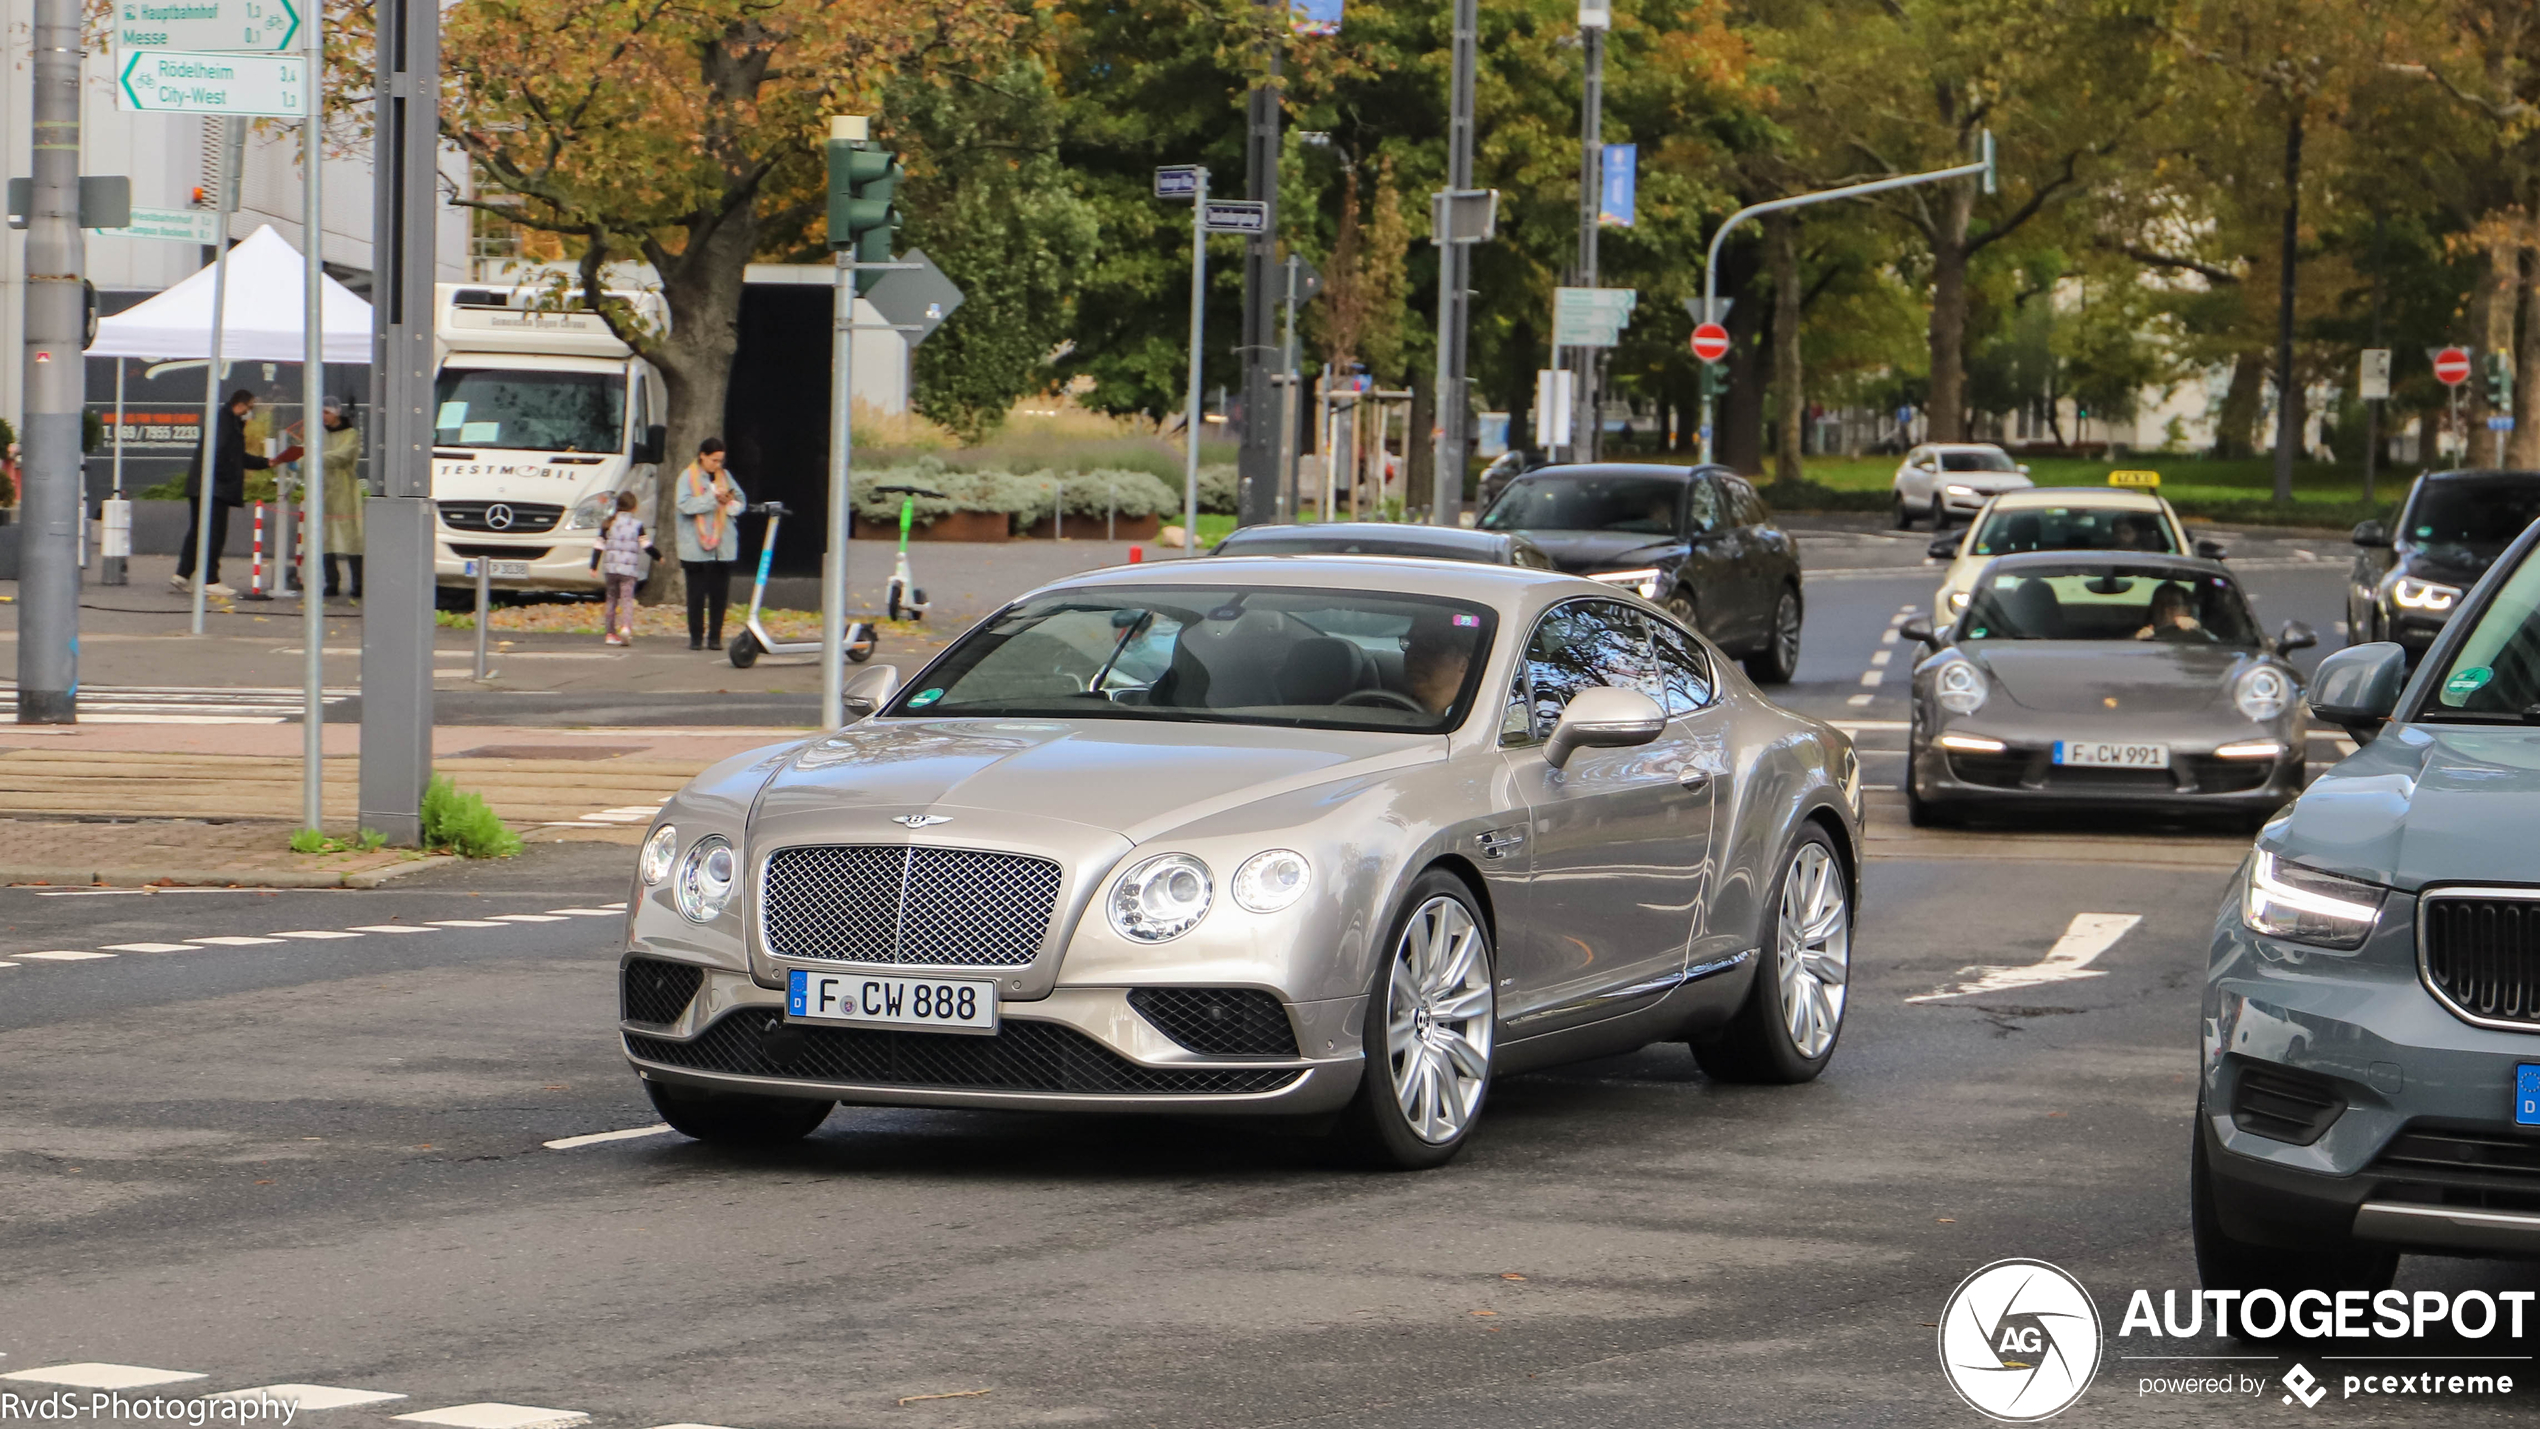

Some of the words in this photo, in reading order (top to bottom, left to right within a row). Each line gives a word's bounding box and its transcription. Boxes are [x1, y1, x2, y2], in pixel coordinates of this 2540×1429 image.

[141, 3, 219, 24] Hauptbahnhof
[122, 29, 168, 45] Messe
[158, 60, 234, 80] Rödelheim
[158, 86, 227, 107] City-West
[172, 425, 200, 440] 2233
[2072, 744, 2085, 762] F
[2097, 745, 2122, 763] CW
[2126, 746, 2161, 764] 991
[819, 978, 839, 1012] F
[862, 981, 905, 1017] CW
[913, 984, 976, 1020] 888
[2524, 1099, 2536, 1114] D
